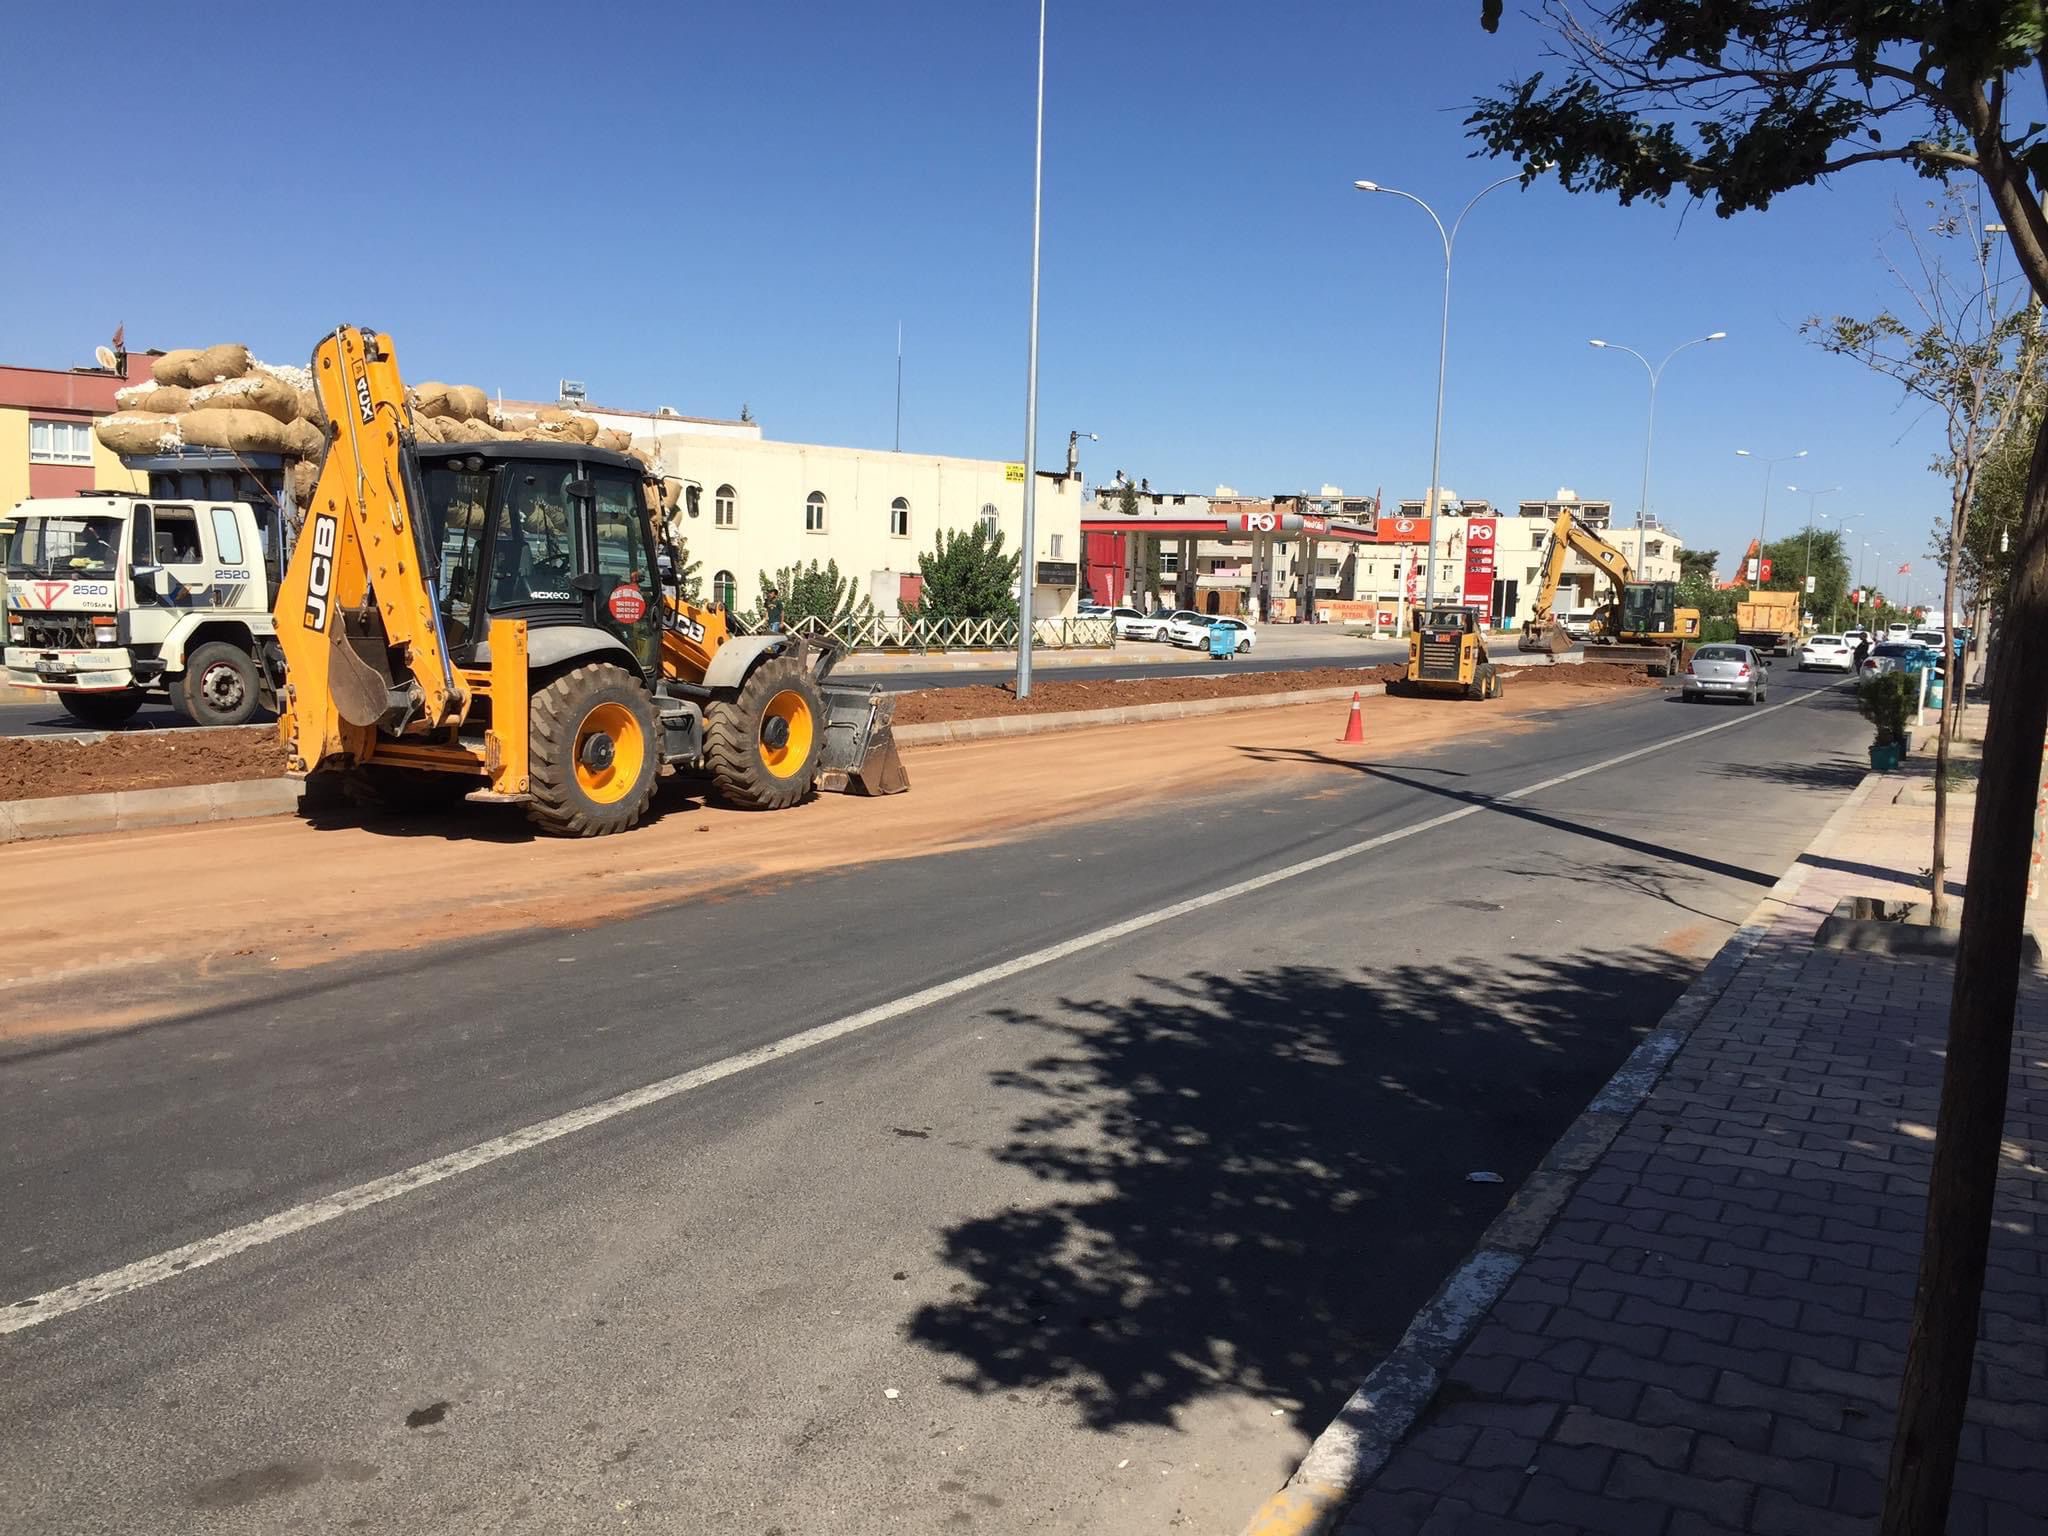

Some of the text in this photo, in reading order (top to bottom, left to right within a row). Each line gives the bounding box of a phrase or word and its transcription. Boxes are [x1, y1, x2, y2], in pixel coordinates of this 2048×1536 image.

[356, 377, 374, 421] 4CX
[73, 585, 108, 595] 2520
[214, 569, 250, 579] 2520
[307, 516, 336, 629] JCB
[662, 608, 704, 643] JCB
